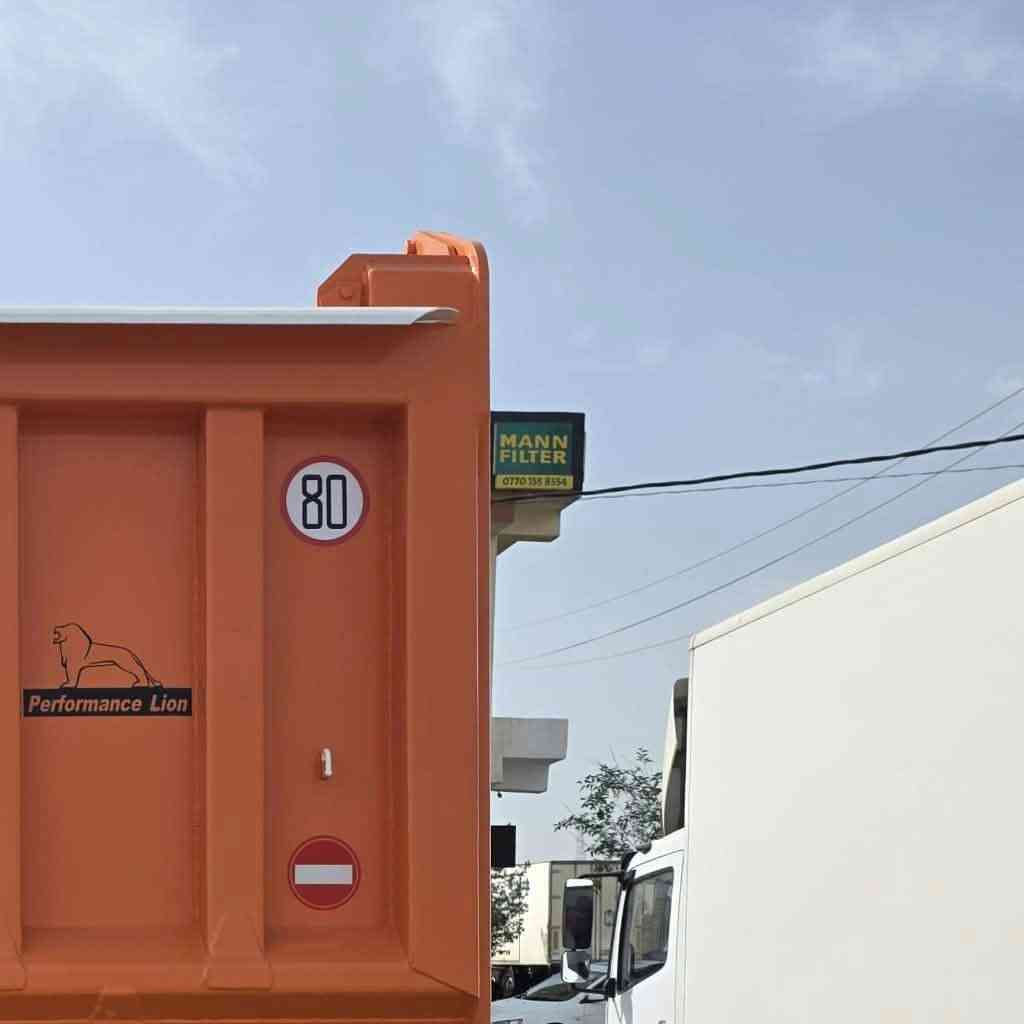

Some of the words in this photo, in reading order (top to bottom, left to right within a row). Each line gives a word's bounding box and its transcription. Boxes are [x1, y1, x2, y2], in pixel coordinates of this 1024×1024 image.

[499, 433, 568, 449] MANN
[499, 449, 567, 465] FILTER
[301, 474, 347, 530] 80
[28, 694, 144, 714] Performance
[150, 693, 189, 714] Lion
